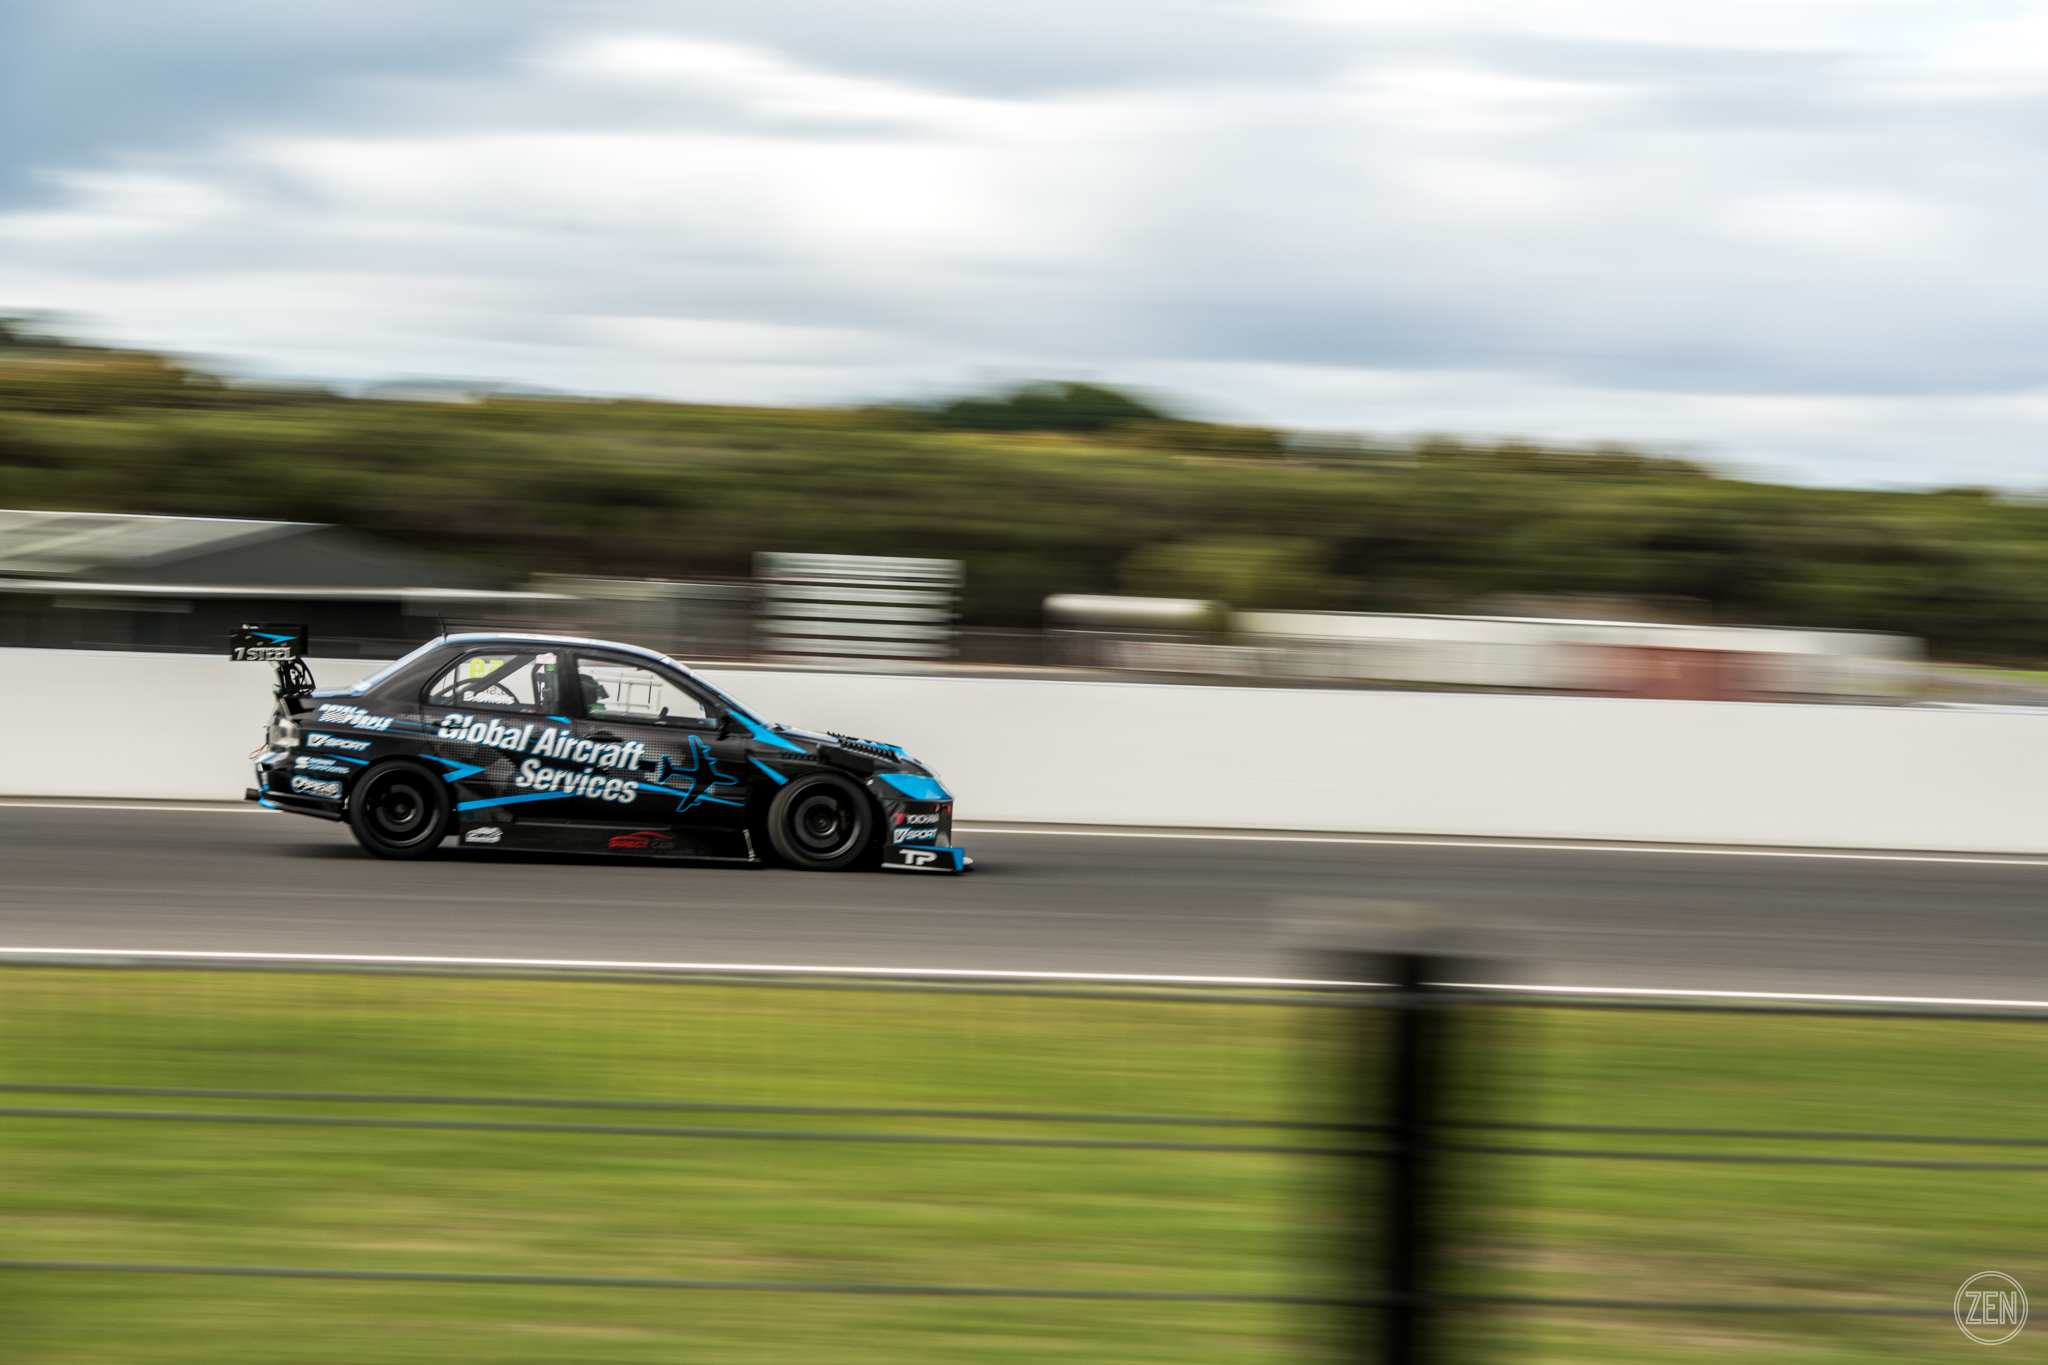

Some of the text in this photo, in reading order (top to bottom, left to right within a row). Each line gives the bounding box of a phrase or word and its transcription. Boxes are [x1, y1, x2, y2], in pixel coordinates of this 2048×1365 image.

[234, 646, 297, 661] 7 STEEL
[437, 713, 645, 771] Global Aircraft
[515, 757, 640, 803] Services
[899, 848, 938, 866] TP
